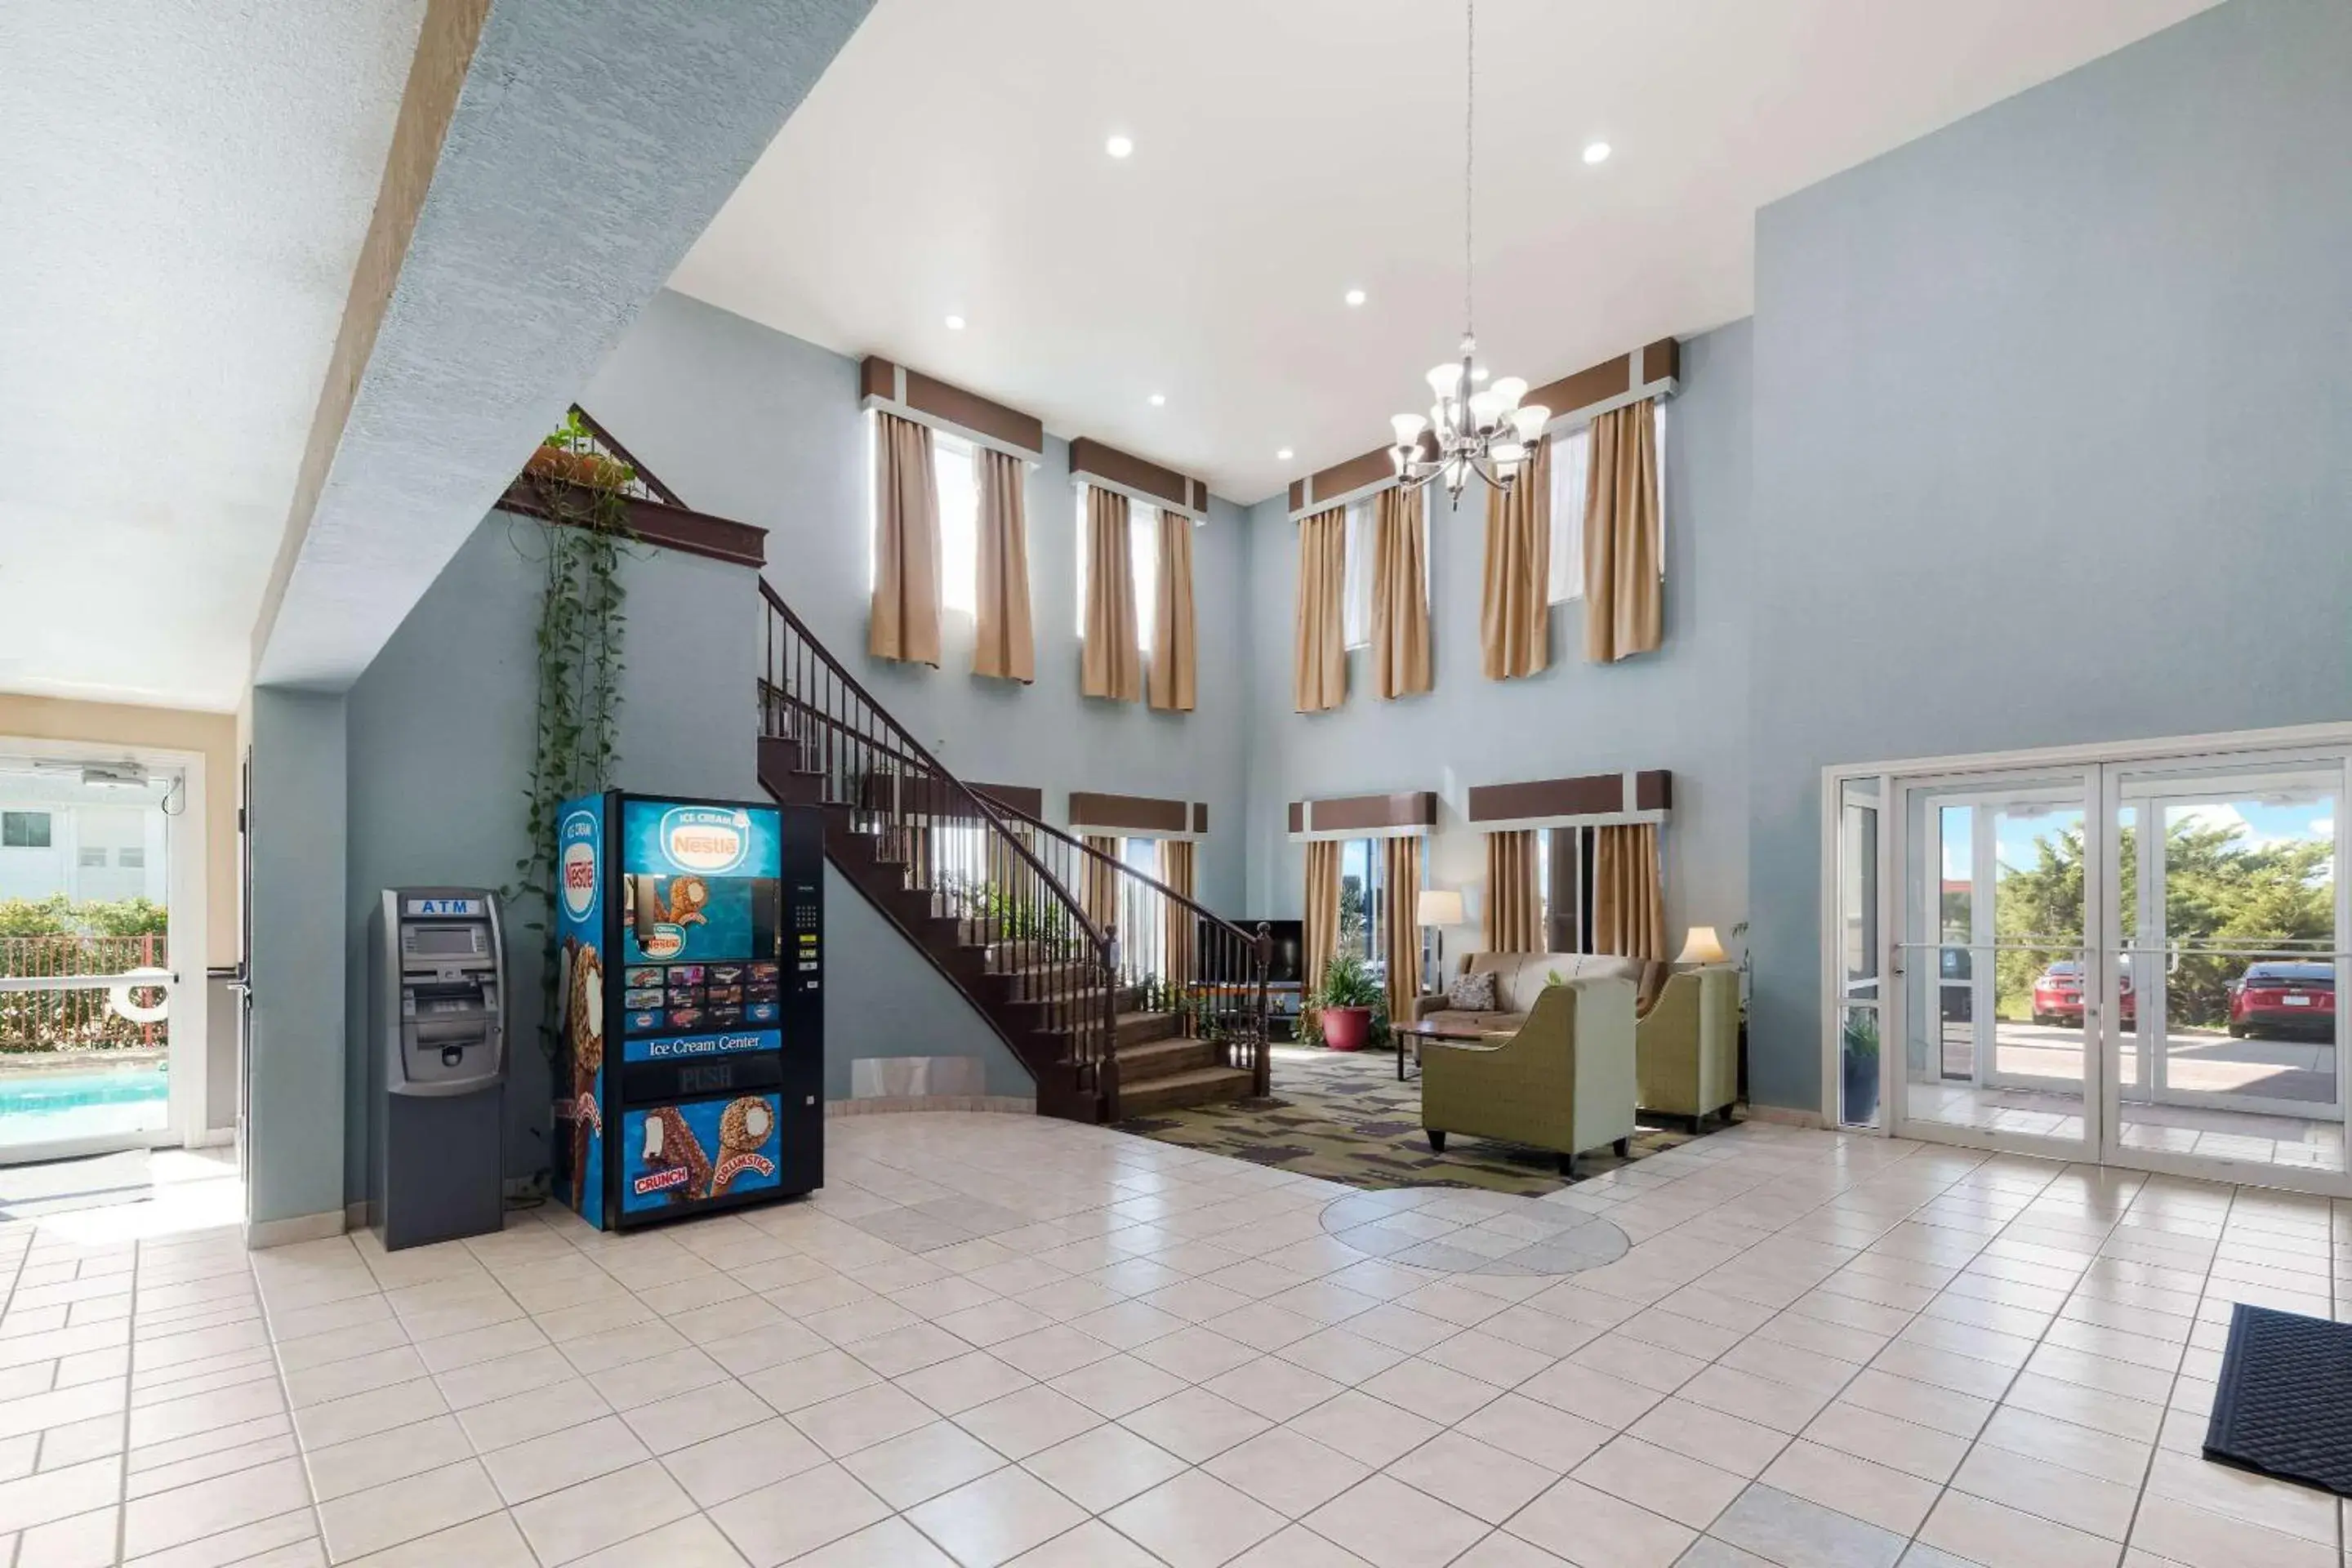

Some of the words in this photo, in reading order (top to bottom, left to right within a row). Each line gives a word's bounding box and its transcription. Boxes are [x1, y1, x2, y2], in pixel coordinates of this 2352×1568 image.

[679, 813, 694, 824] ICE
[697, 813, 733, 826] CREAM
[422, 901, 467, 913] ATM
[649, 1042, 670, 1056] Ice
[673, 1039, 715, 1054] Cream
[719, 1036, 760, 1050] Center
[716, 1154, 773, 1184] DRUMSTICK
[636, 1168, 687, 1192] CRUNCH
